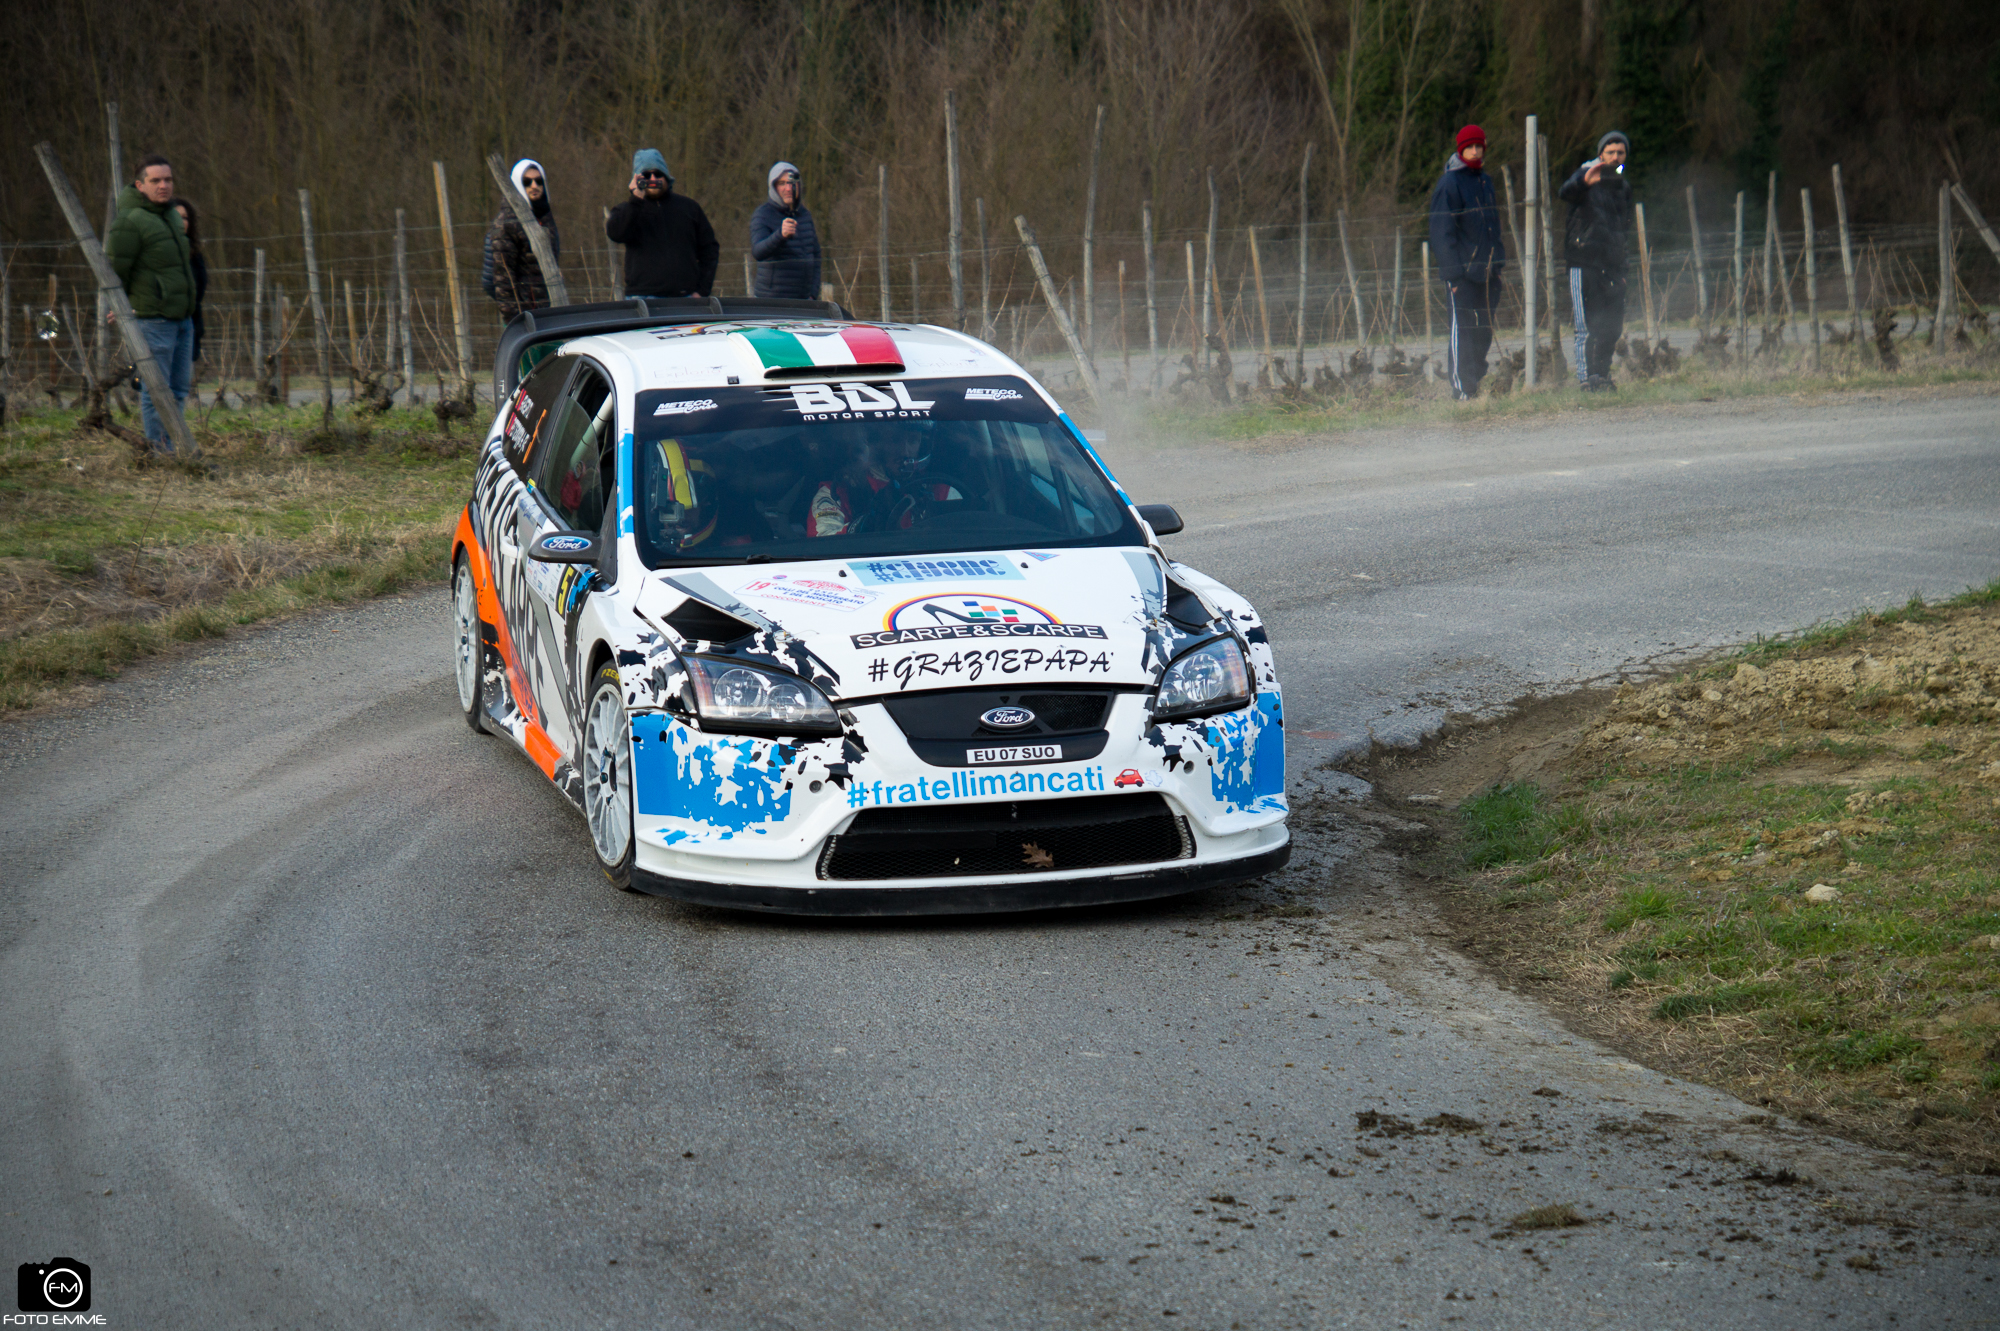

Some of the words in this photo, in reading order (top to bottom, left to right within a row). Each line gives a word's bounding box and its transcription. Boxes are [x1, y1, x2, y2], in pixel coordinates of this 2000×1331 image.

[788, 381, 936, 413] BDL
[966, 387, 1017, 395] METECO
[657, 399, 714, 409] METECO
[803, 411, 865, 421] MOTOR
[874, 410, 931, 419] SPORT
[548, 538, 582, 550] Ford
[856, 624, 1104, 648] SCARPE&SCARPE
[993, 710, 1024, 723] Ford
[973, 750, 996, 762] EU
[999, 749, 1018, 761] 07
[1021, 746, 1056, 760] SUO
[847, 766, 1105, 808] #fratellimancati
